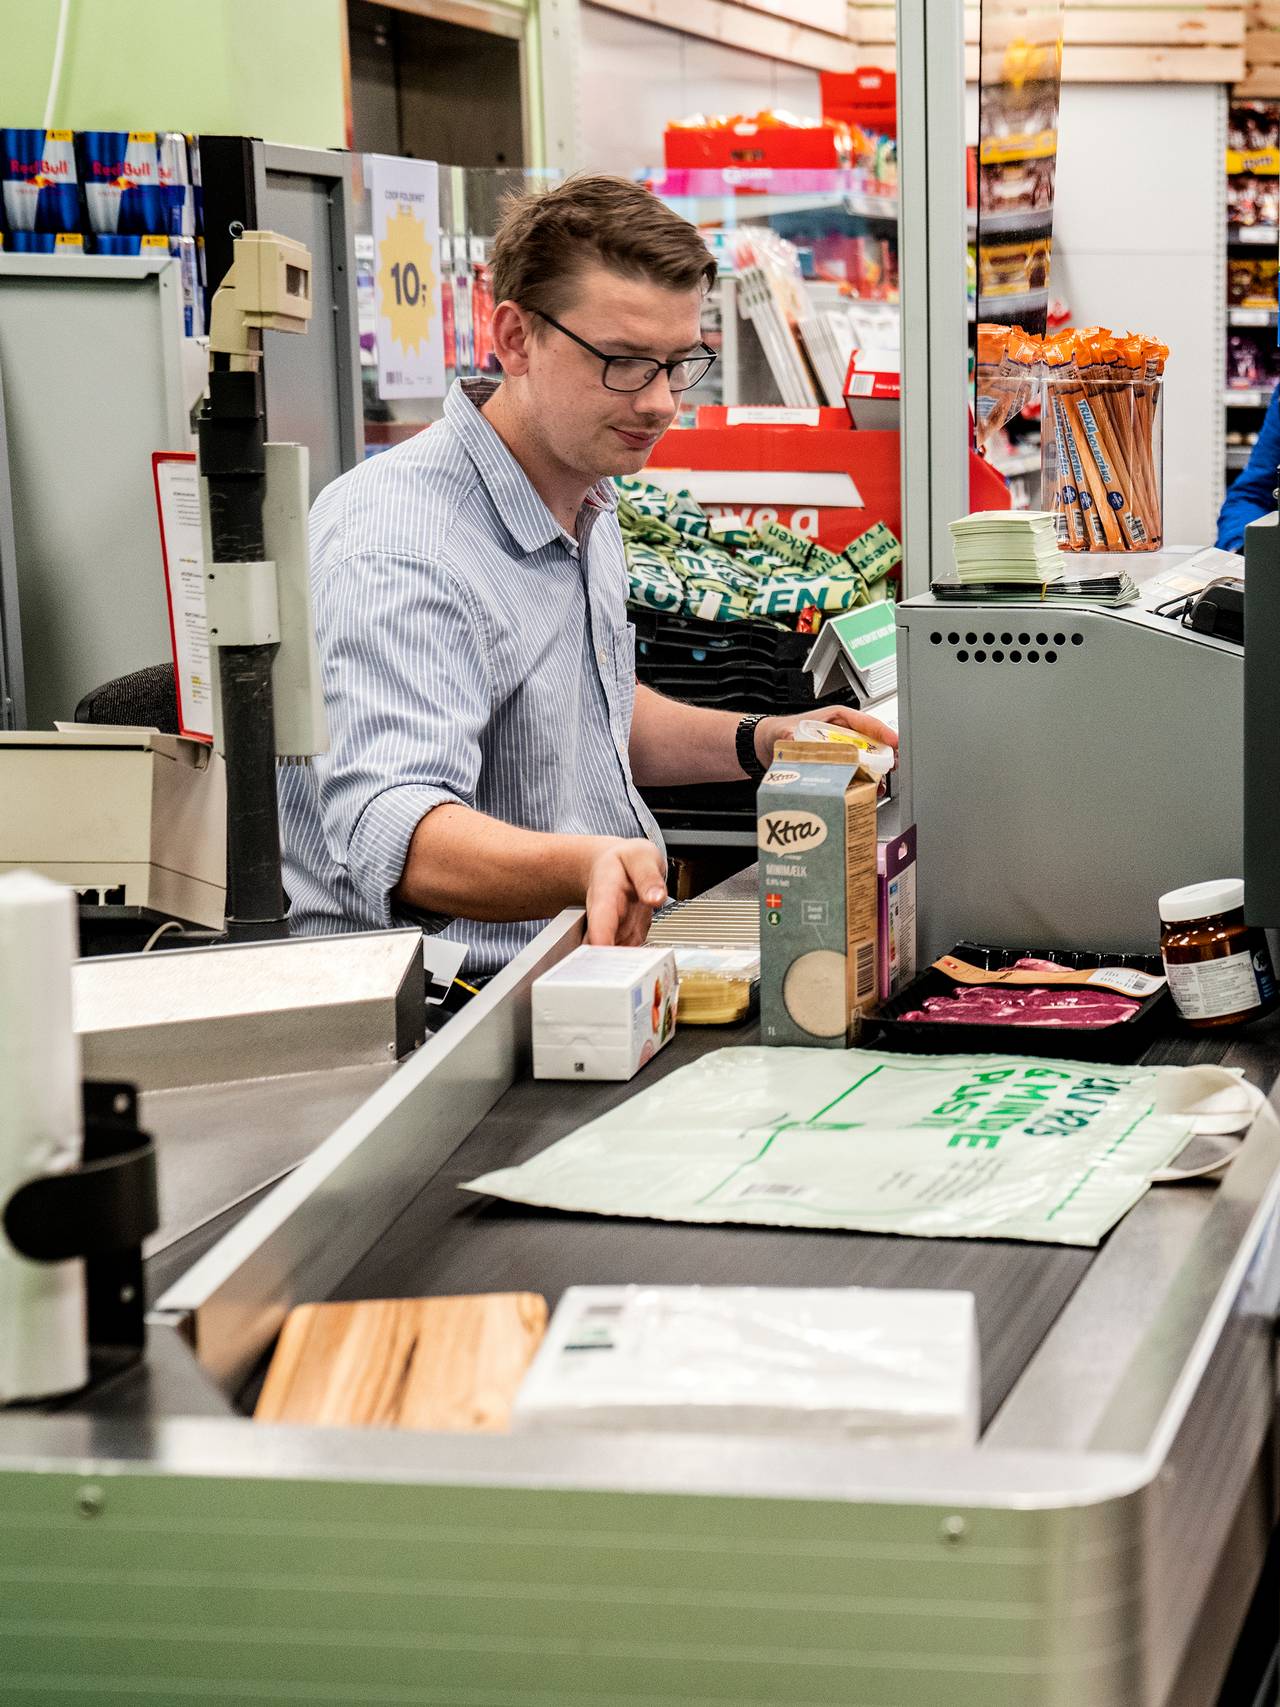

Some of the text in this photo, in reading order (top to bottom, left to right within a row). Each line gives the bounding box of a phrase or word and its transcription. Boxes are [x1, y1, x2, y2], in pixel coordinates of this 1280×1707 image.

[10, 160, 68, 175] Red Bull
[92, 161, 150, 176] Red Bull
[1077, 399, 1100, 433] TRUXA
[766, 818, 821, 846] Xtra
